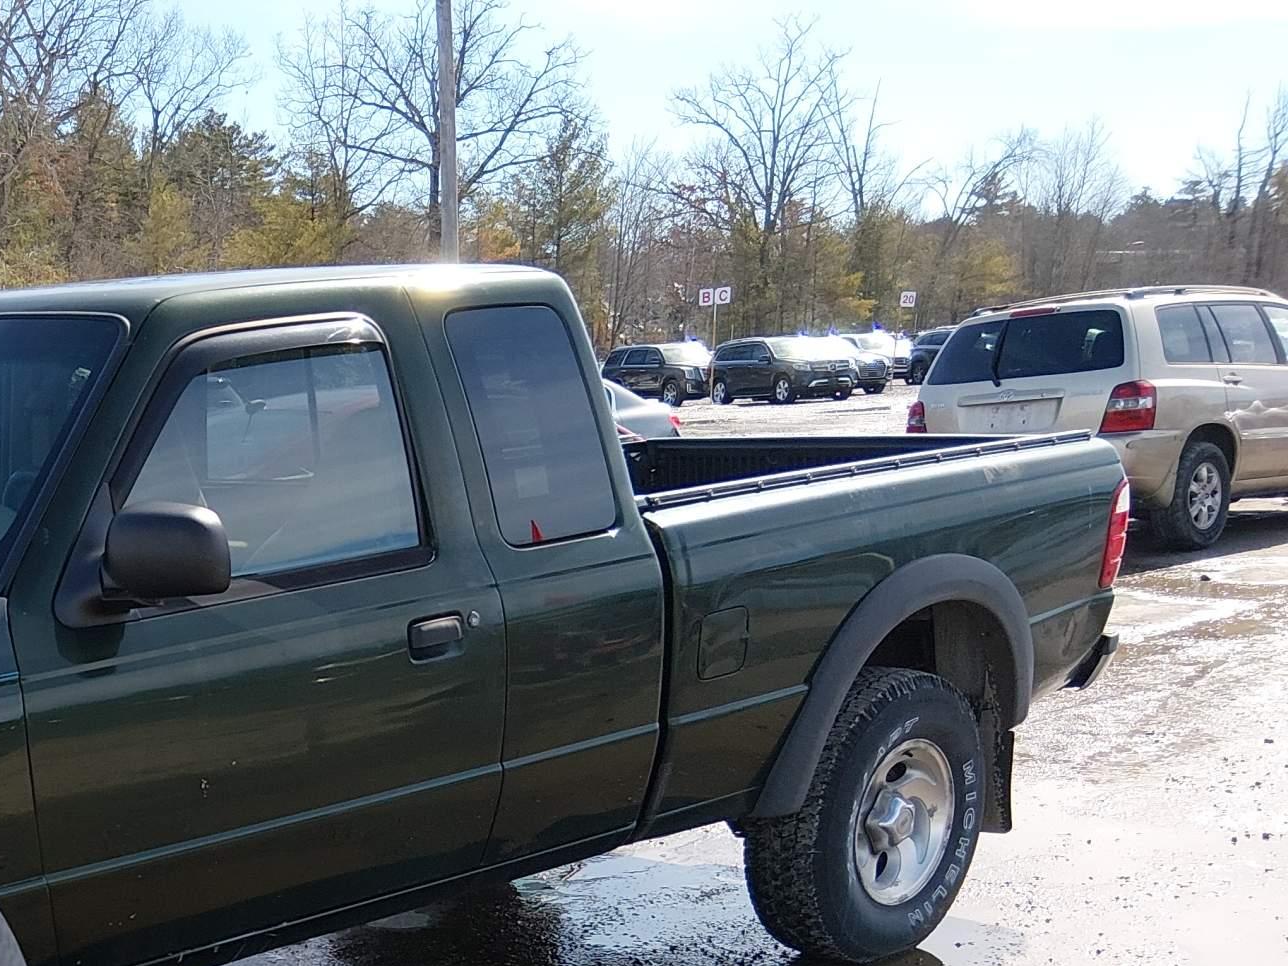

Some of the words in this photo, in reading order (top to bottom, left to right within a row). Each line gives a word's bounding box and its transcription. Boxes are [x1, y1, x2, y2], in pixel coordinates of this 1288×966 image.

[702, 291, 711, 304] B
[718, 289, 729, 302] C
[902, 294, 915, 304] 20
[908, 760, 977, 927] MICHELIN
